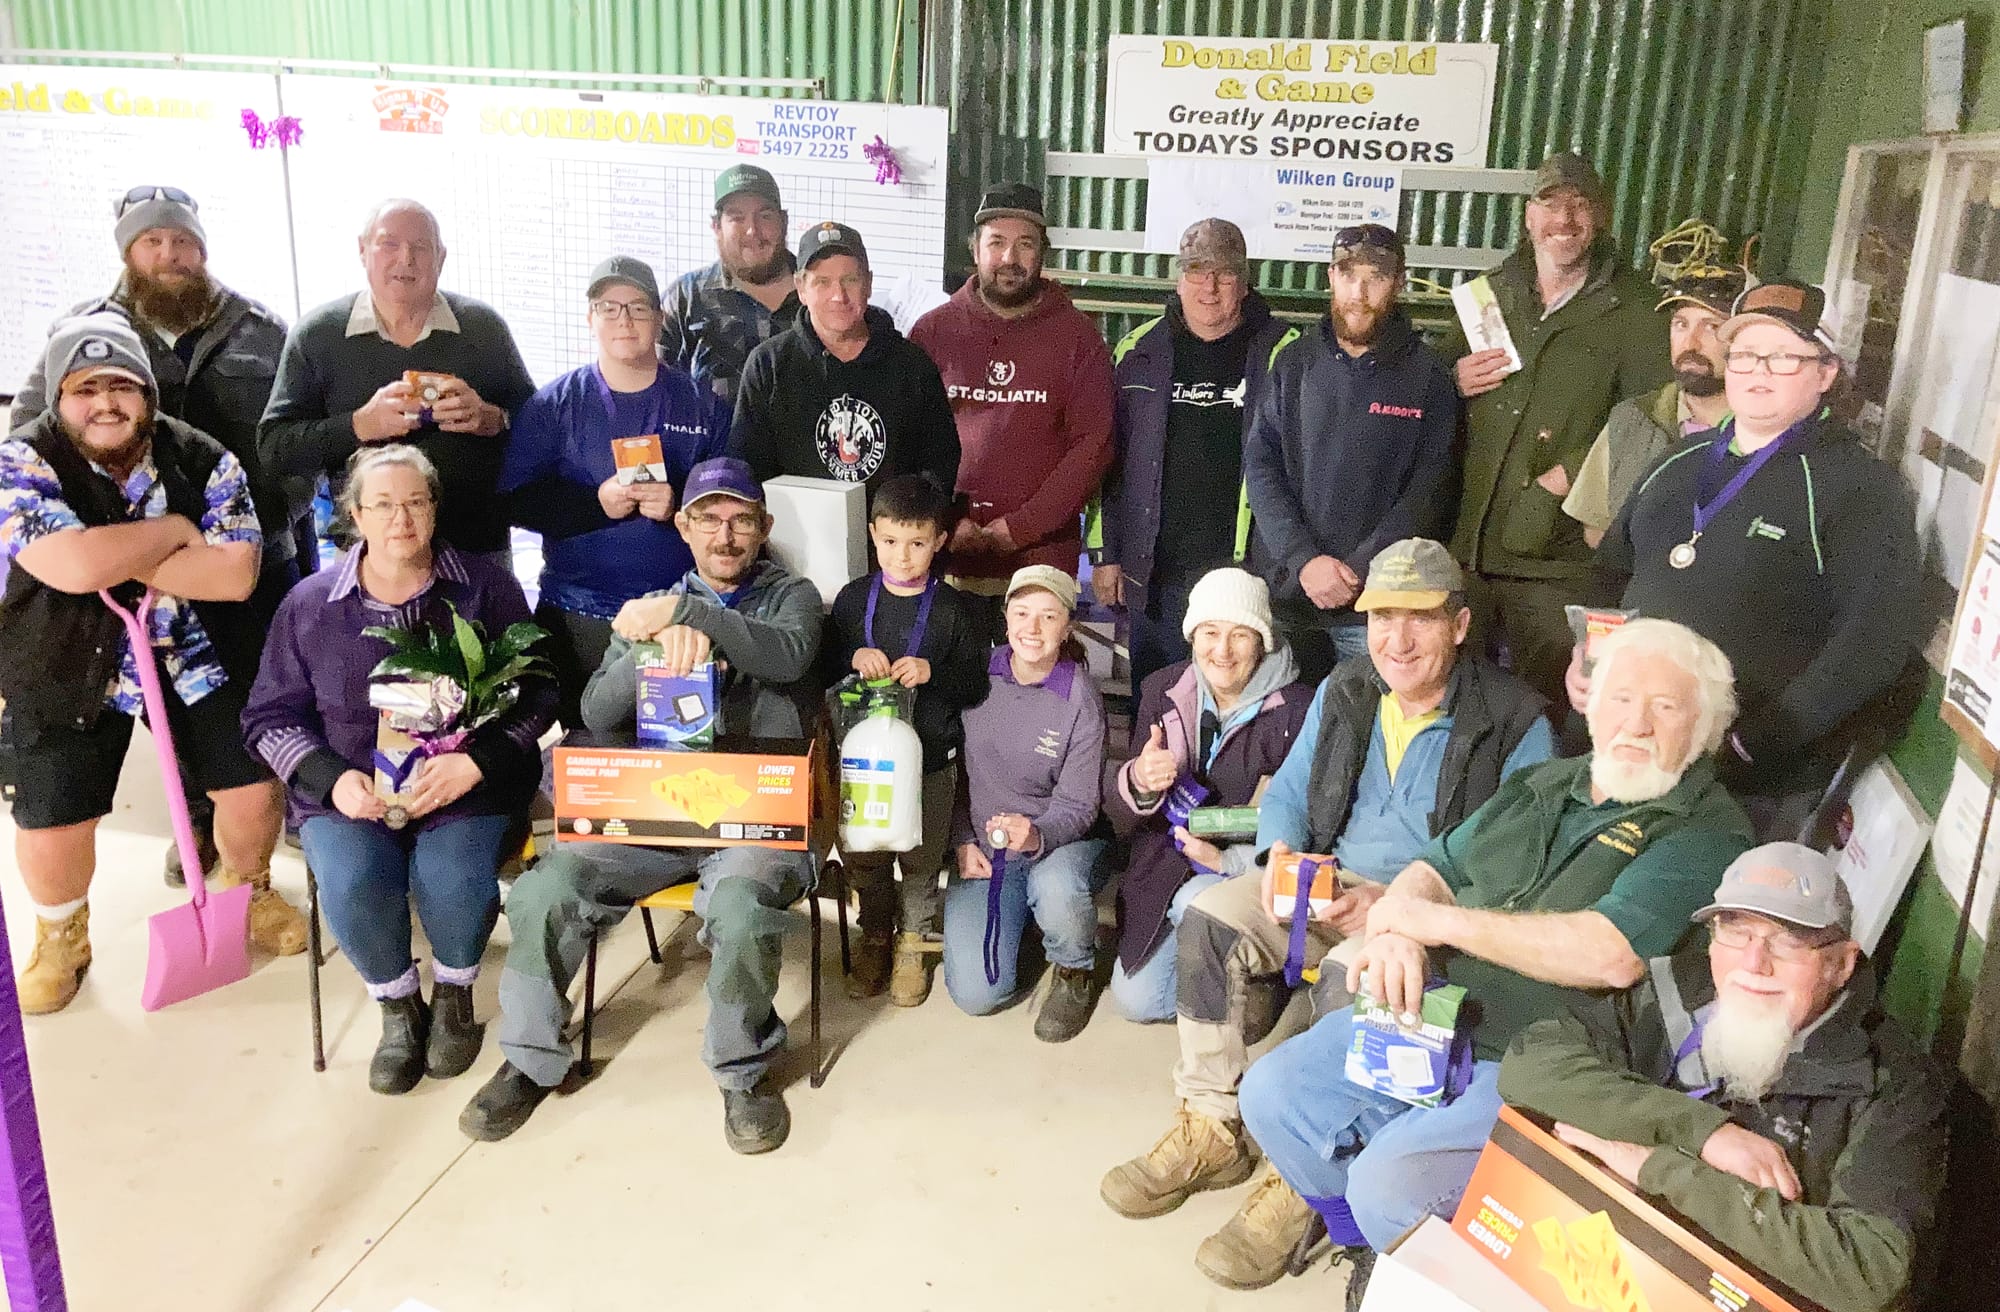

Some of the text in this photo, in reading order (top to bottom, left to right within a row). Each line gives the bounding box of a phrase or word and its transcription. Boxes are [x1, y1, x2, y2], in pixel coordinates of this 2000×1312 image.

[1162, 40, 1438, 75] Donald Field
[1215, 74, 1375, 103] & Game
[63, 88, 96, 114] &
[103, 87, 214, 120] Game
[774, 104, 840, 122] REVTOY
[480, 106, 736, 149] SCOREBOARDS
[756, 121, 857, 141] TRANSPORT
[1169, 104, 1420, 133] Greatly Appreciate
[763, 140, 802, 157] 5497
[809, 141, 849, 159] 2225
[1133, 131, 1454, 163] TODAYS SPONSORS
[1277, 169, 1394, 192] Wilken Group
[947, 384, 1047, 403] ST.GOLIATH
[861, 440, 885, 476] TOUR
[609, 757, 653, 768] LEVELLER
[757, 764, 795, 775] LOWER
[757, 776, 791, 786] PRICES
[1467, 1218, 1512, 1260] LOWER
[1477, 1207, 1519, 1243] PRICES
